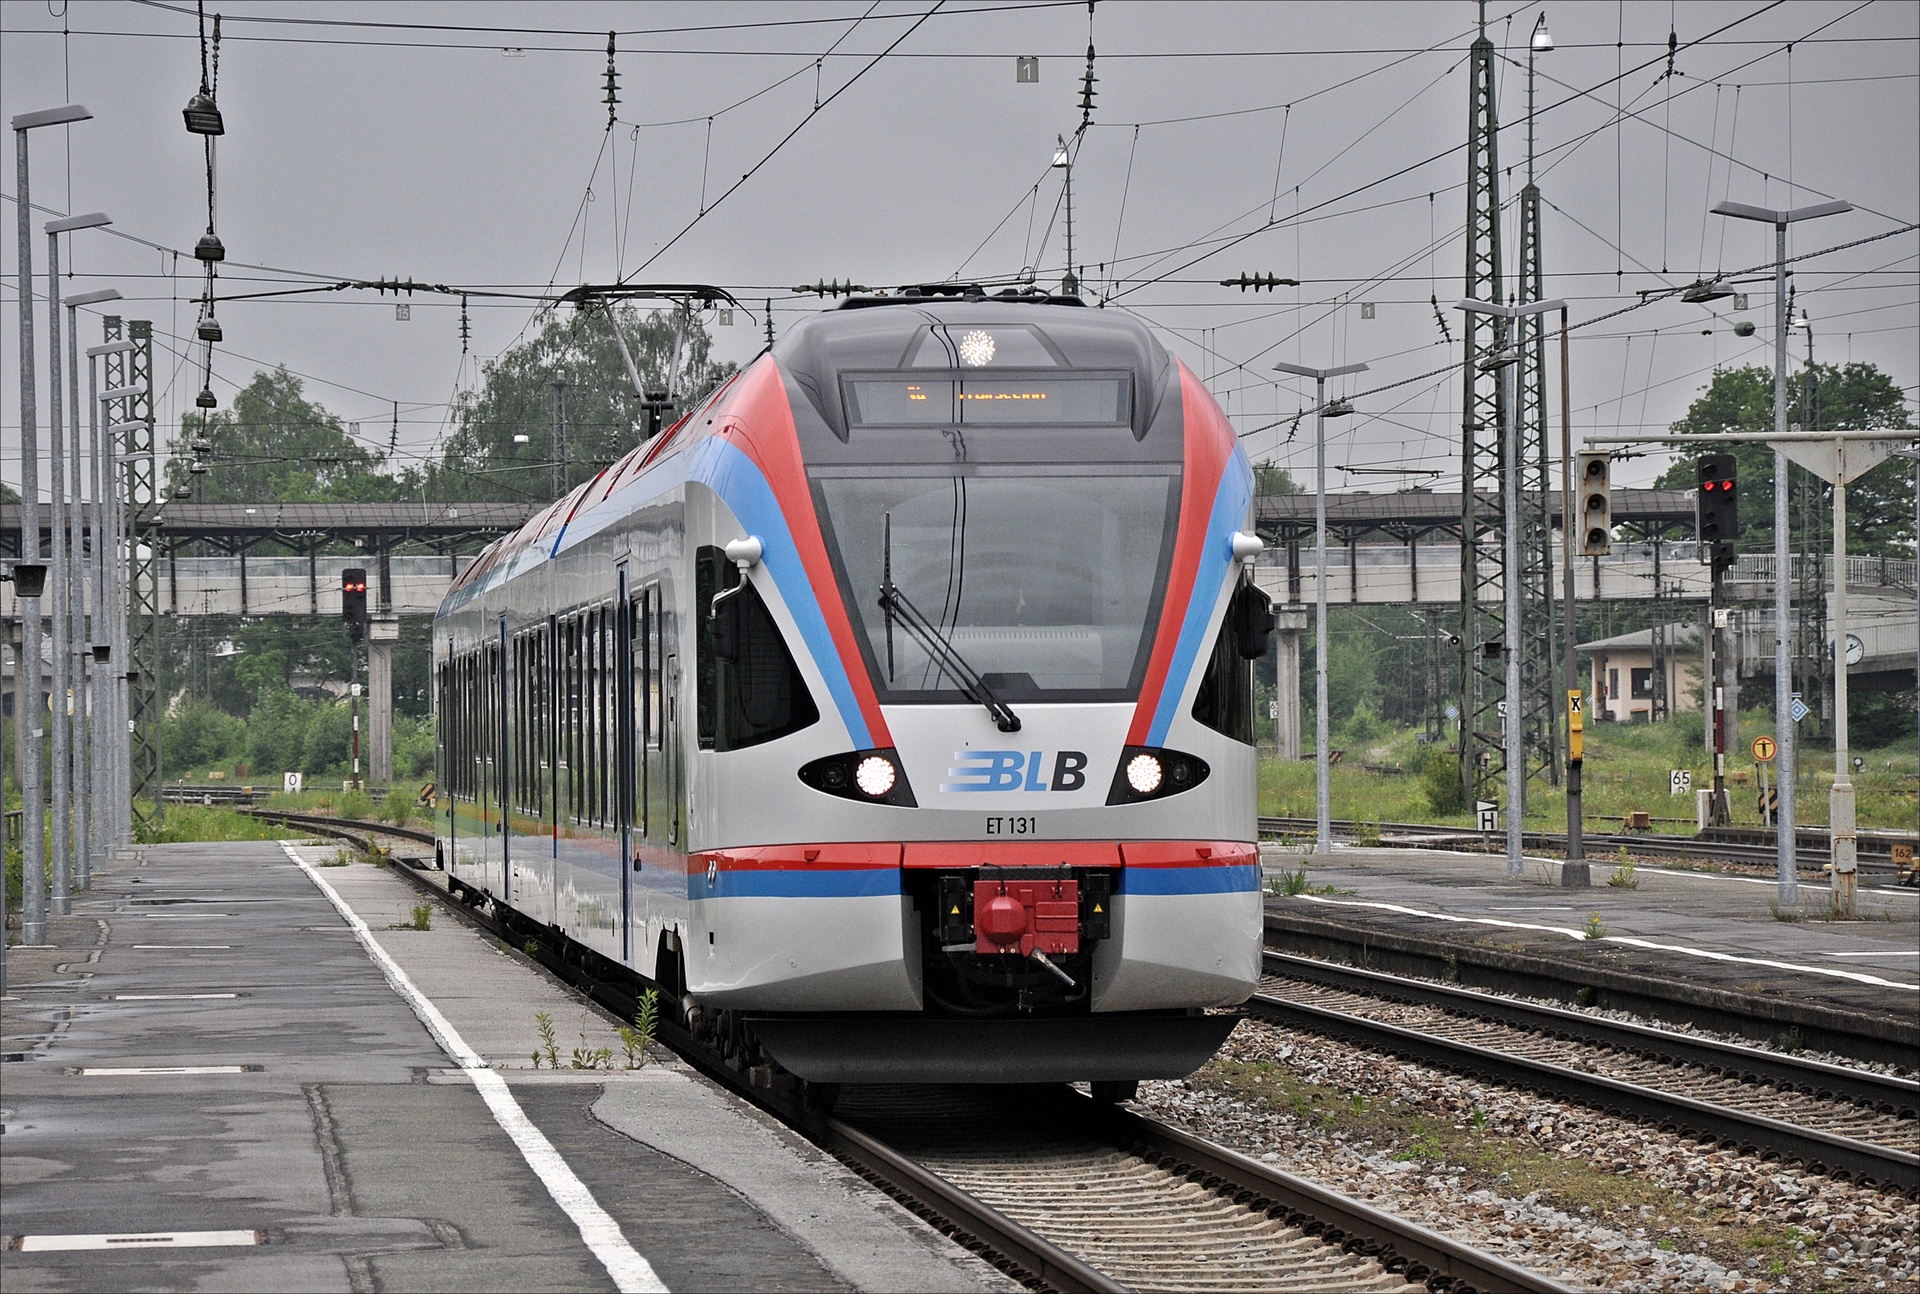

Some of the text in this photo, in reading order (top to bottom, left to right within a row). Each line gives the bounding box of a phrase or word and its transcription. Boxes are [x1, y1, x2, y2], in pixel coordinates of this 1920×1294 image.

[1023, 63, 1030, 80] 1
[1737, 297, 1745, 309] 2
[398, 308, 409, 319] 13
[1365, 306, 1371, 318] 1
[723, 313, 729, 324] 1
[948, 750, 1088, 792] BLB
[289, 774, 297, 786] 0
[1672, 771, 1690, 785] 65
[986, 817, 1036, 834] ET 131
[1482, 812, 1494, 830] H
[1895, 848, 1912, 858] 162
